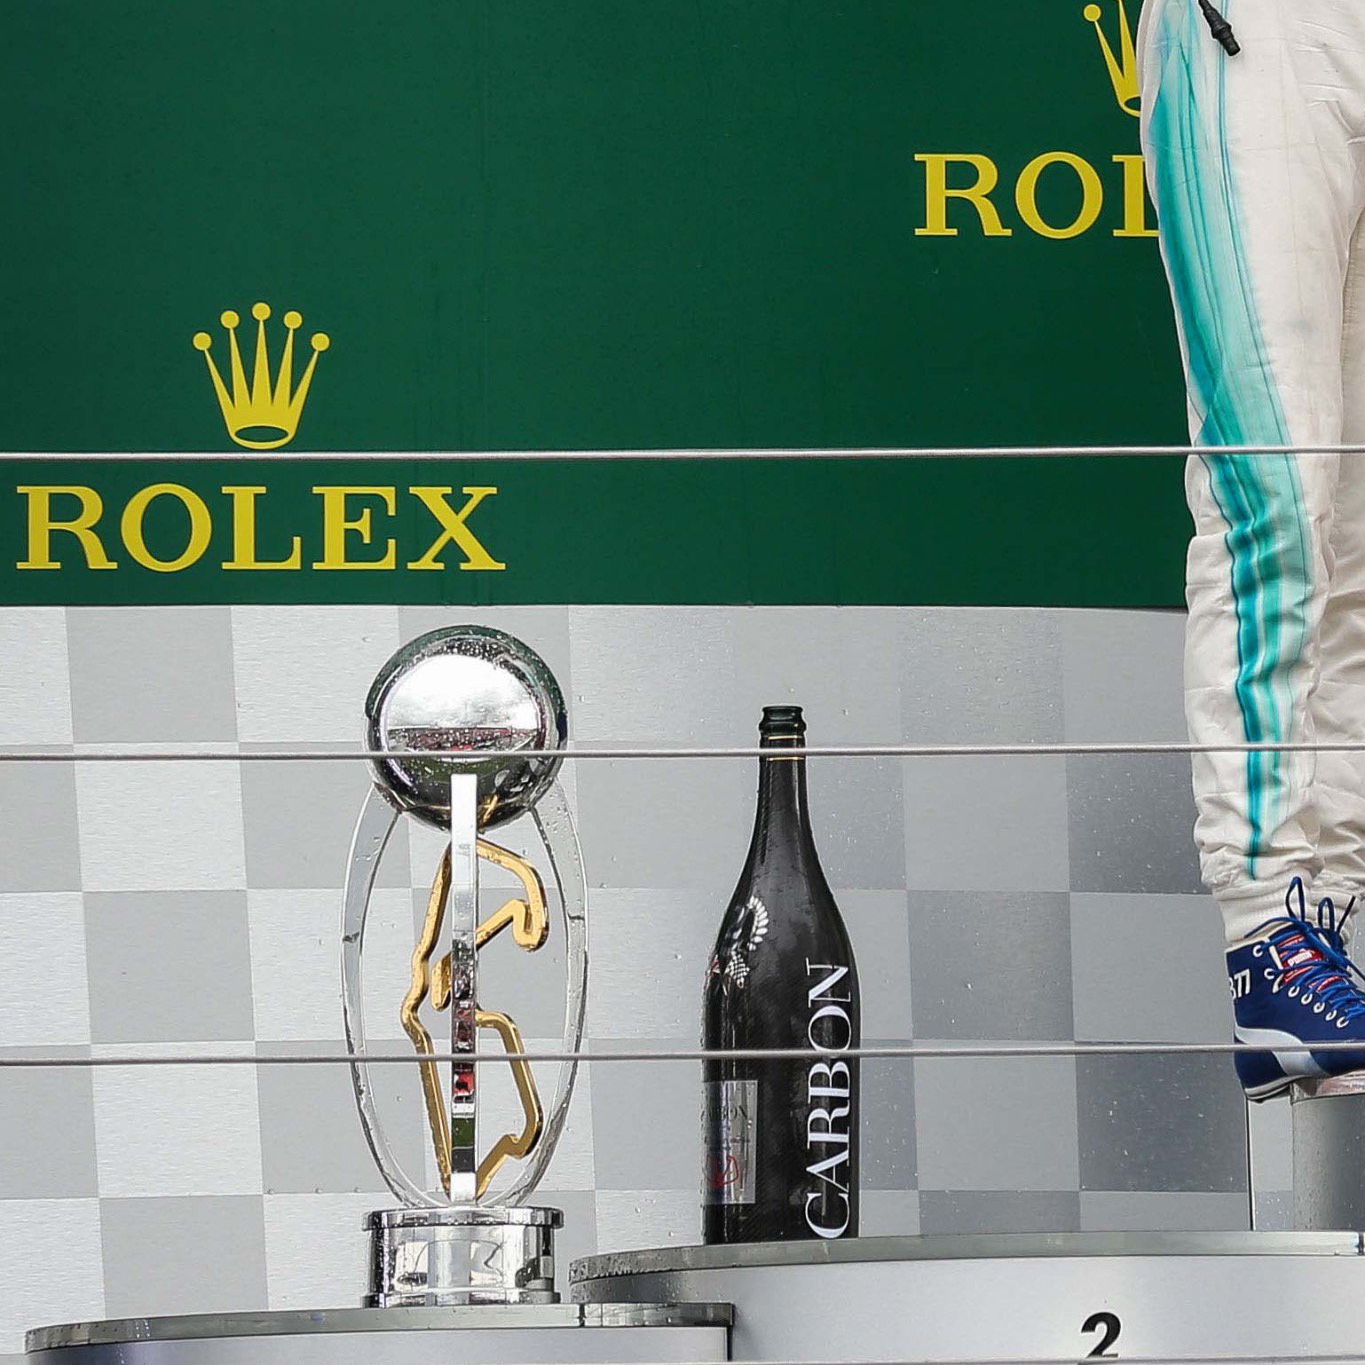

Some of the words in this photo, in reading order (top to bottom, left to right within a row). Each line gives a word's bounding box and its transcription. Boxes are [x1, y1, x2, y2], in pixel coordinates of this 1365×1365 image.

[16, 482, 506, 573] ROLEX
[805, 957, 852, 1239] CARBON
[1078, 1311, 1122, 1365] 2
